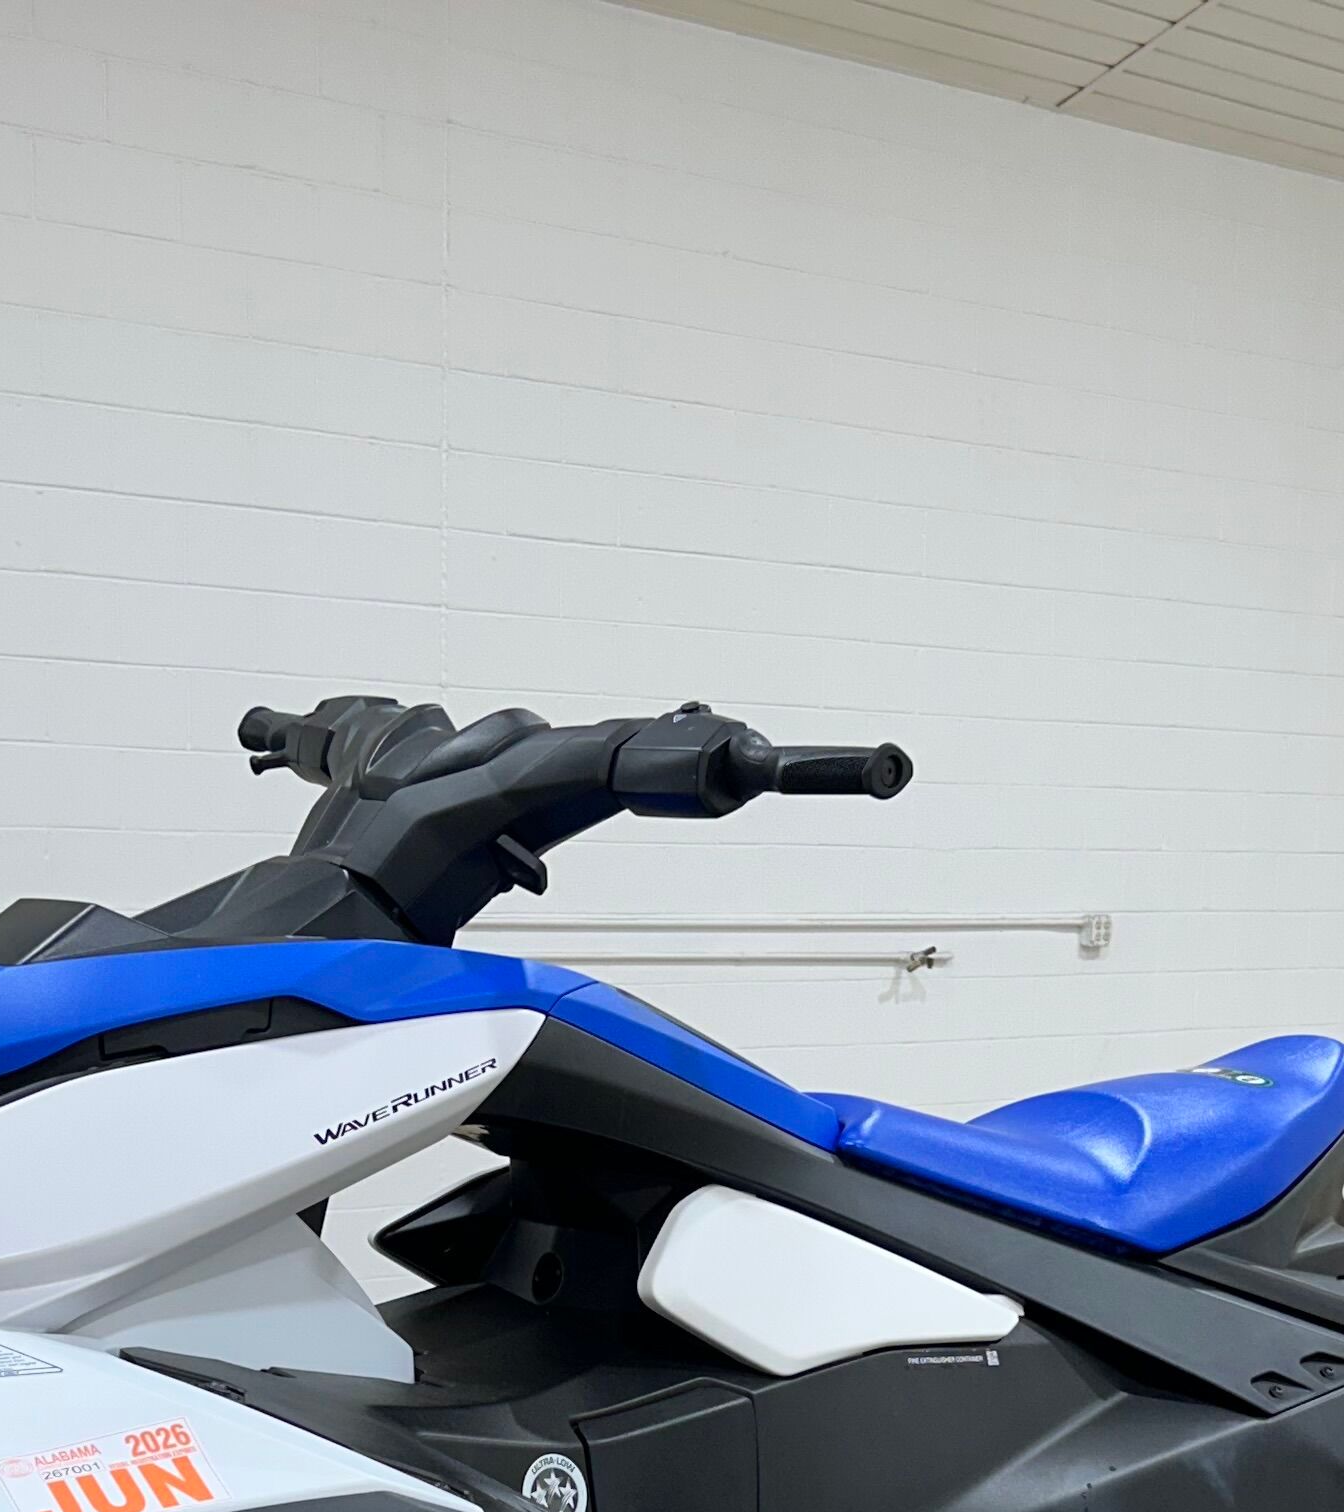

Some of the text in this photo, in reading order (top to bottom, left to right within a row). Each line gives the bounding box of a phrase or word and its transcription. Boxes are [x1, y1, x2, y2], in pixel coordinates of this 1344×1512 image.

[34, 1444, 102, 1467] ALABAMA
[125, 1423, 192, 1458] 2026
[42, 1462, 101, 1480] 267001
